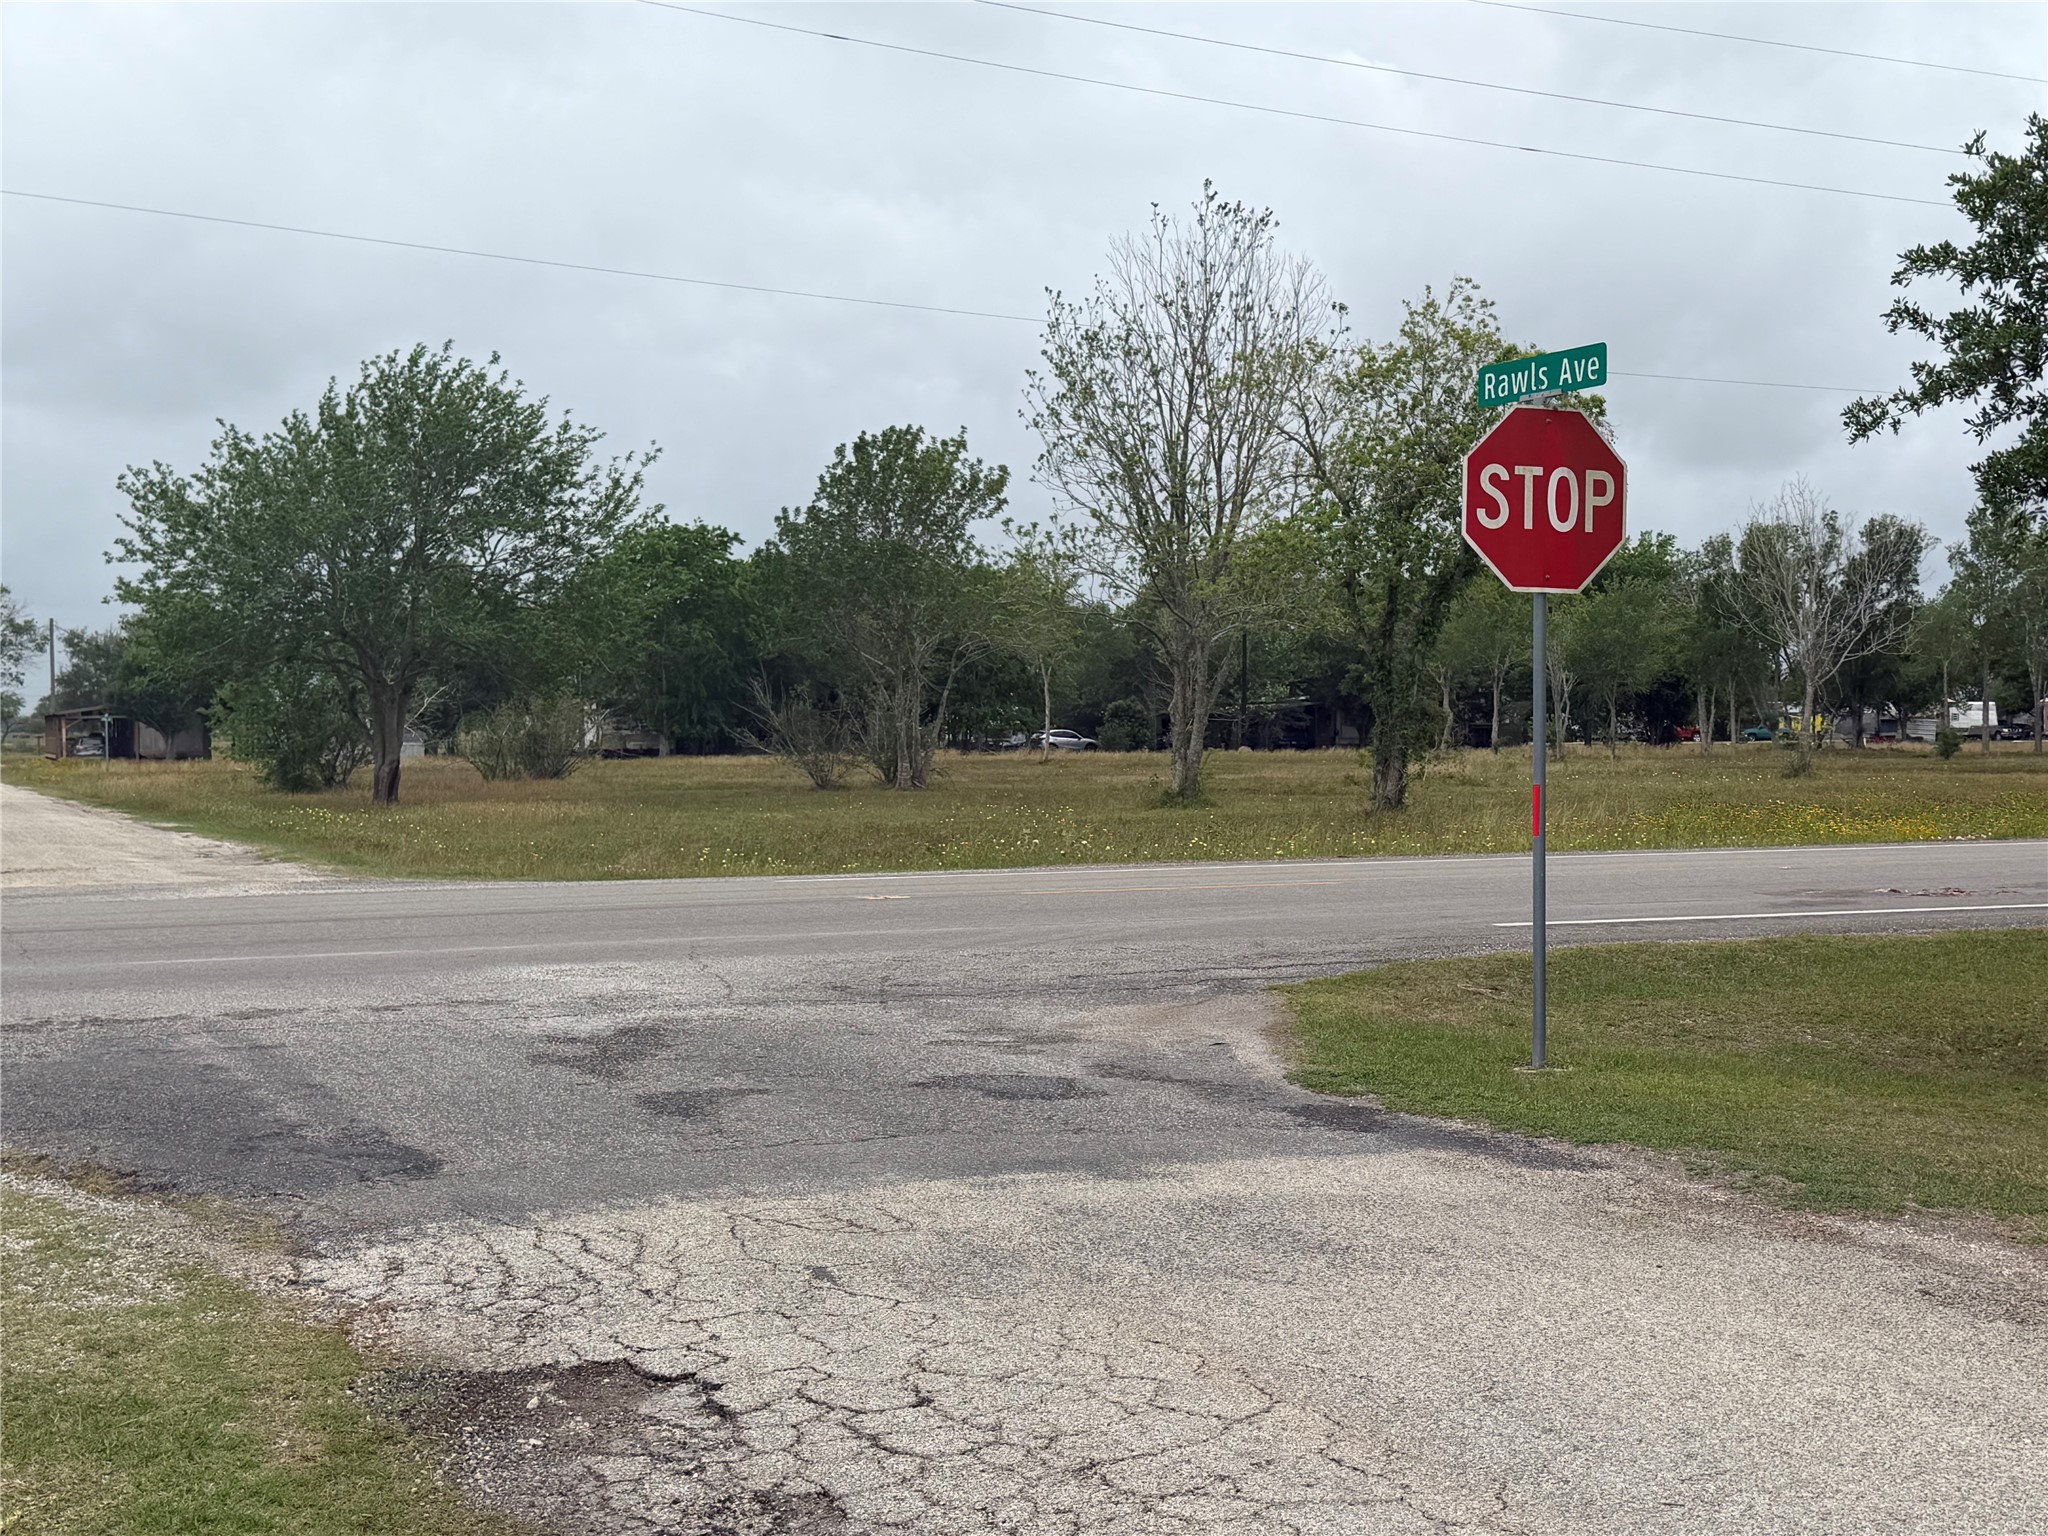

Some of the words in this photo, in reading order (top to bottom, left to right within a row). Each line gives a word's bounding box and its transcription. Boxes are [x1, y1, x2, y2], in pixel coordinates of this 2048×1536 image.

[1484, 362, 1548, 400] Rawls
[1558, 356, 1600, 386] Ave
[1476, 463, 1615, 533] STOP
